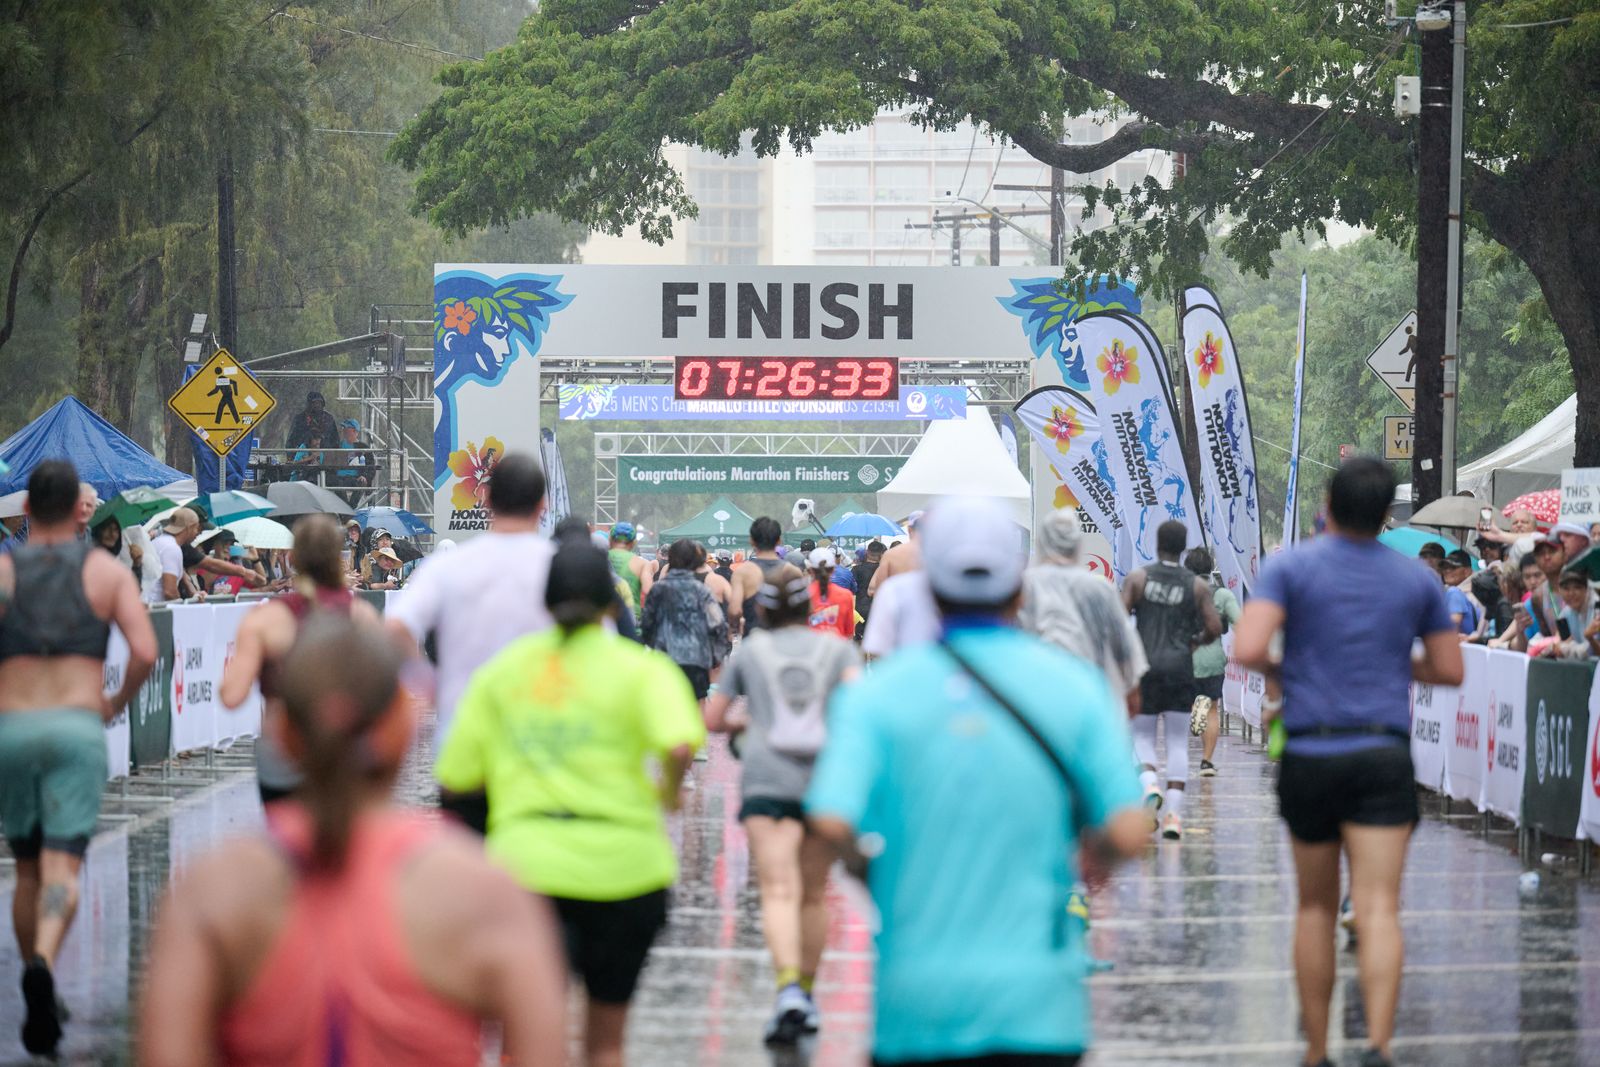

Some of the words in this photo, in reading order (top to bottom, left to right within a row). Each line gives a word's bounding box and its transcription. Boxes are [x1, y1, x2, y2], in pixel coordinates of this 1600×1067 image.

[662, 282, 914, 340] FINISH
[679, 361, 894, 397] 07:26:33
[622, 395, 658, 412] MEN'S
[1397, 422, 1415, 436] PE
[1111, 413, 1139, 483] HONOLULU
[1121, 410, 1159, 507] MARATHON
[1203, 408, 1232, 499] HONOLULU
[1212, 403, 1243, 497] MARATHON
[1394, 439, 1409, 454] YI
[630, 466, 727, 485] Congratulations
[730, 467, 791, 482] Marathon
[795, 467, 850, 482] Finishers
[1071, 466, 1112, 517] HONOLULU
[1134, 485, 1147, 507] JAL
[1565, 485, 1590, 498] THIS
[185, 647, 203, 670] JAPAN
[187, 680, 212, 705] AIRLINES
[1498, 704, 1514, 729] JAPAN
[1415, 717, 1441, 745] AIRLINES
[1497, 743, 1519, 772] AIRLINES
[1549, 714, 1572, 779] SGC
